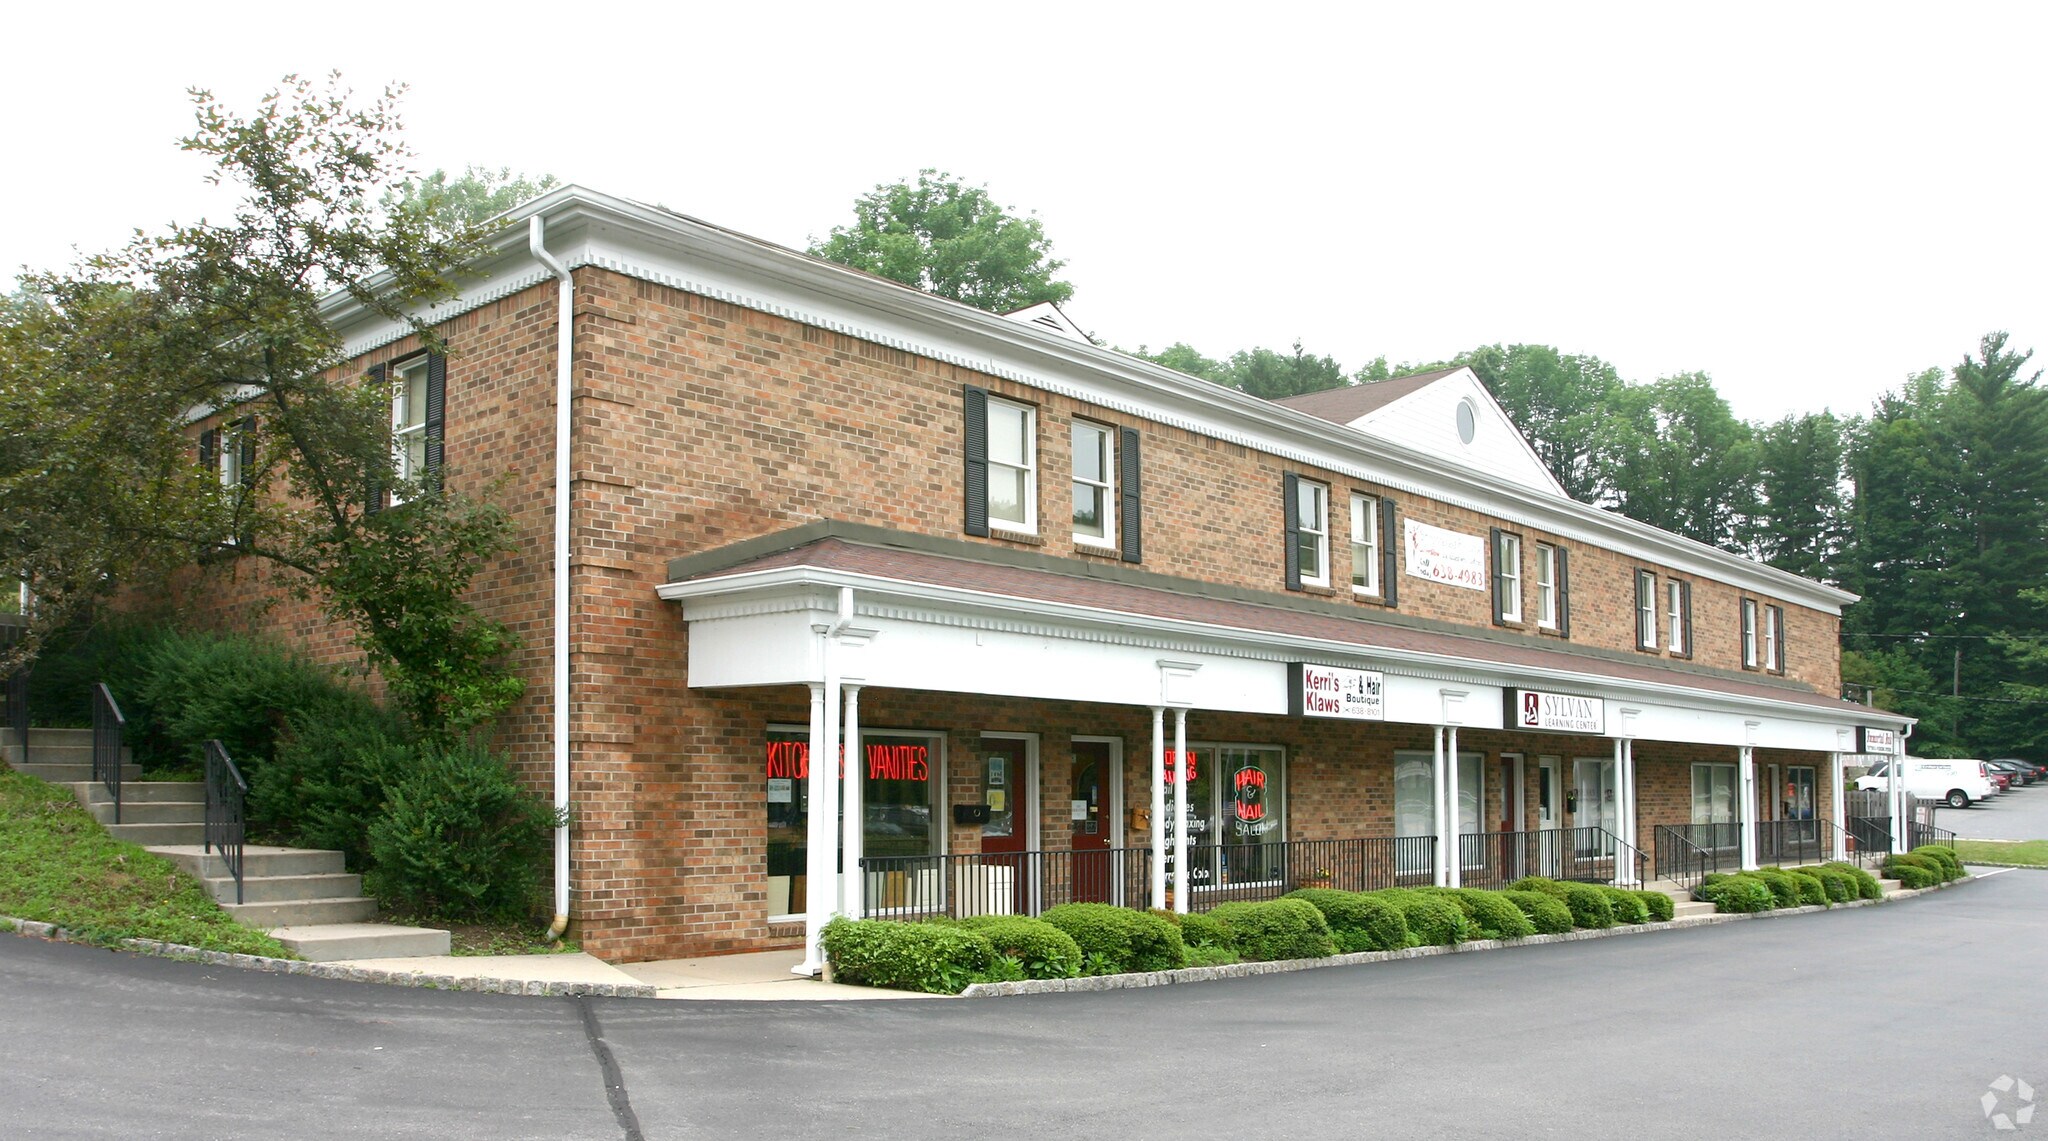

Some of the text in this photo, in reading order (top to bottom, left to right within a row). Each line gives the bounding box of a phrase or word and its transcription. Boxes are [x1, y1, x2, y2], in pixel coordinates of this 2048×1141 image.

[1432, 564, 1483, 586] 638-4983
[1305, 669, 1340, 692] Kerri's
[1358, 674, 1381, 696] & Hair
[1306, 691, 1340, 713] Klaws
[1346, 693, 1380, 706] Boutique
[1545, 695, 1592, 719] SYLVAN
[1545, 718, 1597, 730] LEARNING CENTER
[867, 744, 929, 781] VANITIES
[1236, 768, 1265, 792] HAIR
[1246, 785, 1256, 799] &
[1237, 799, 1265, 820] NAIL
[1235, 821, 1268, 837] SALON
